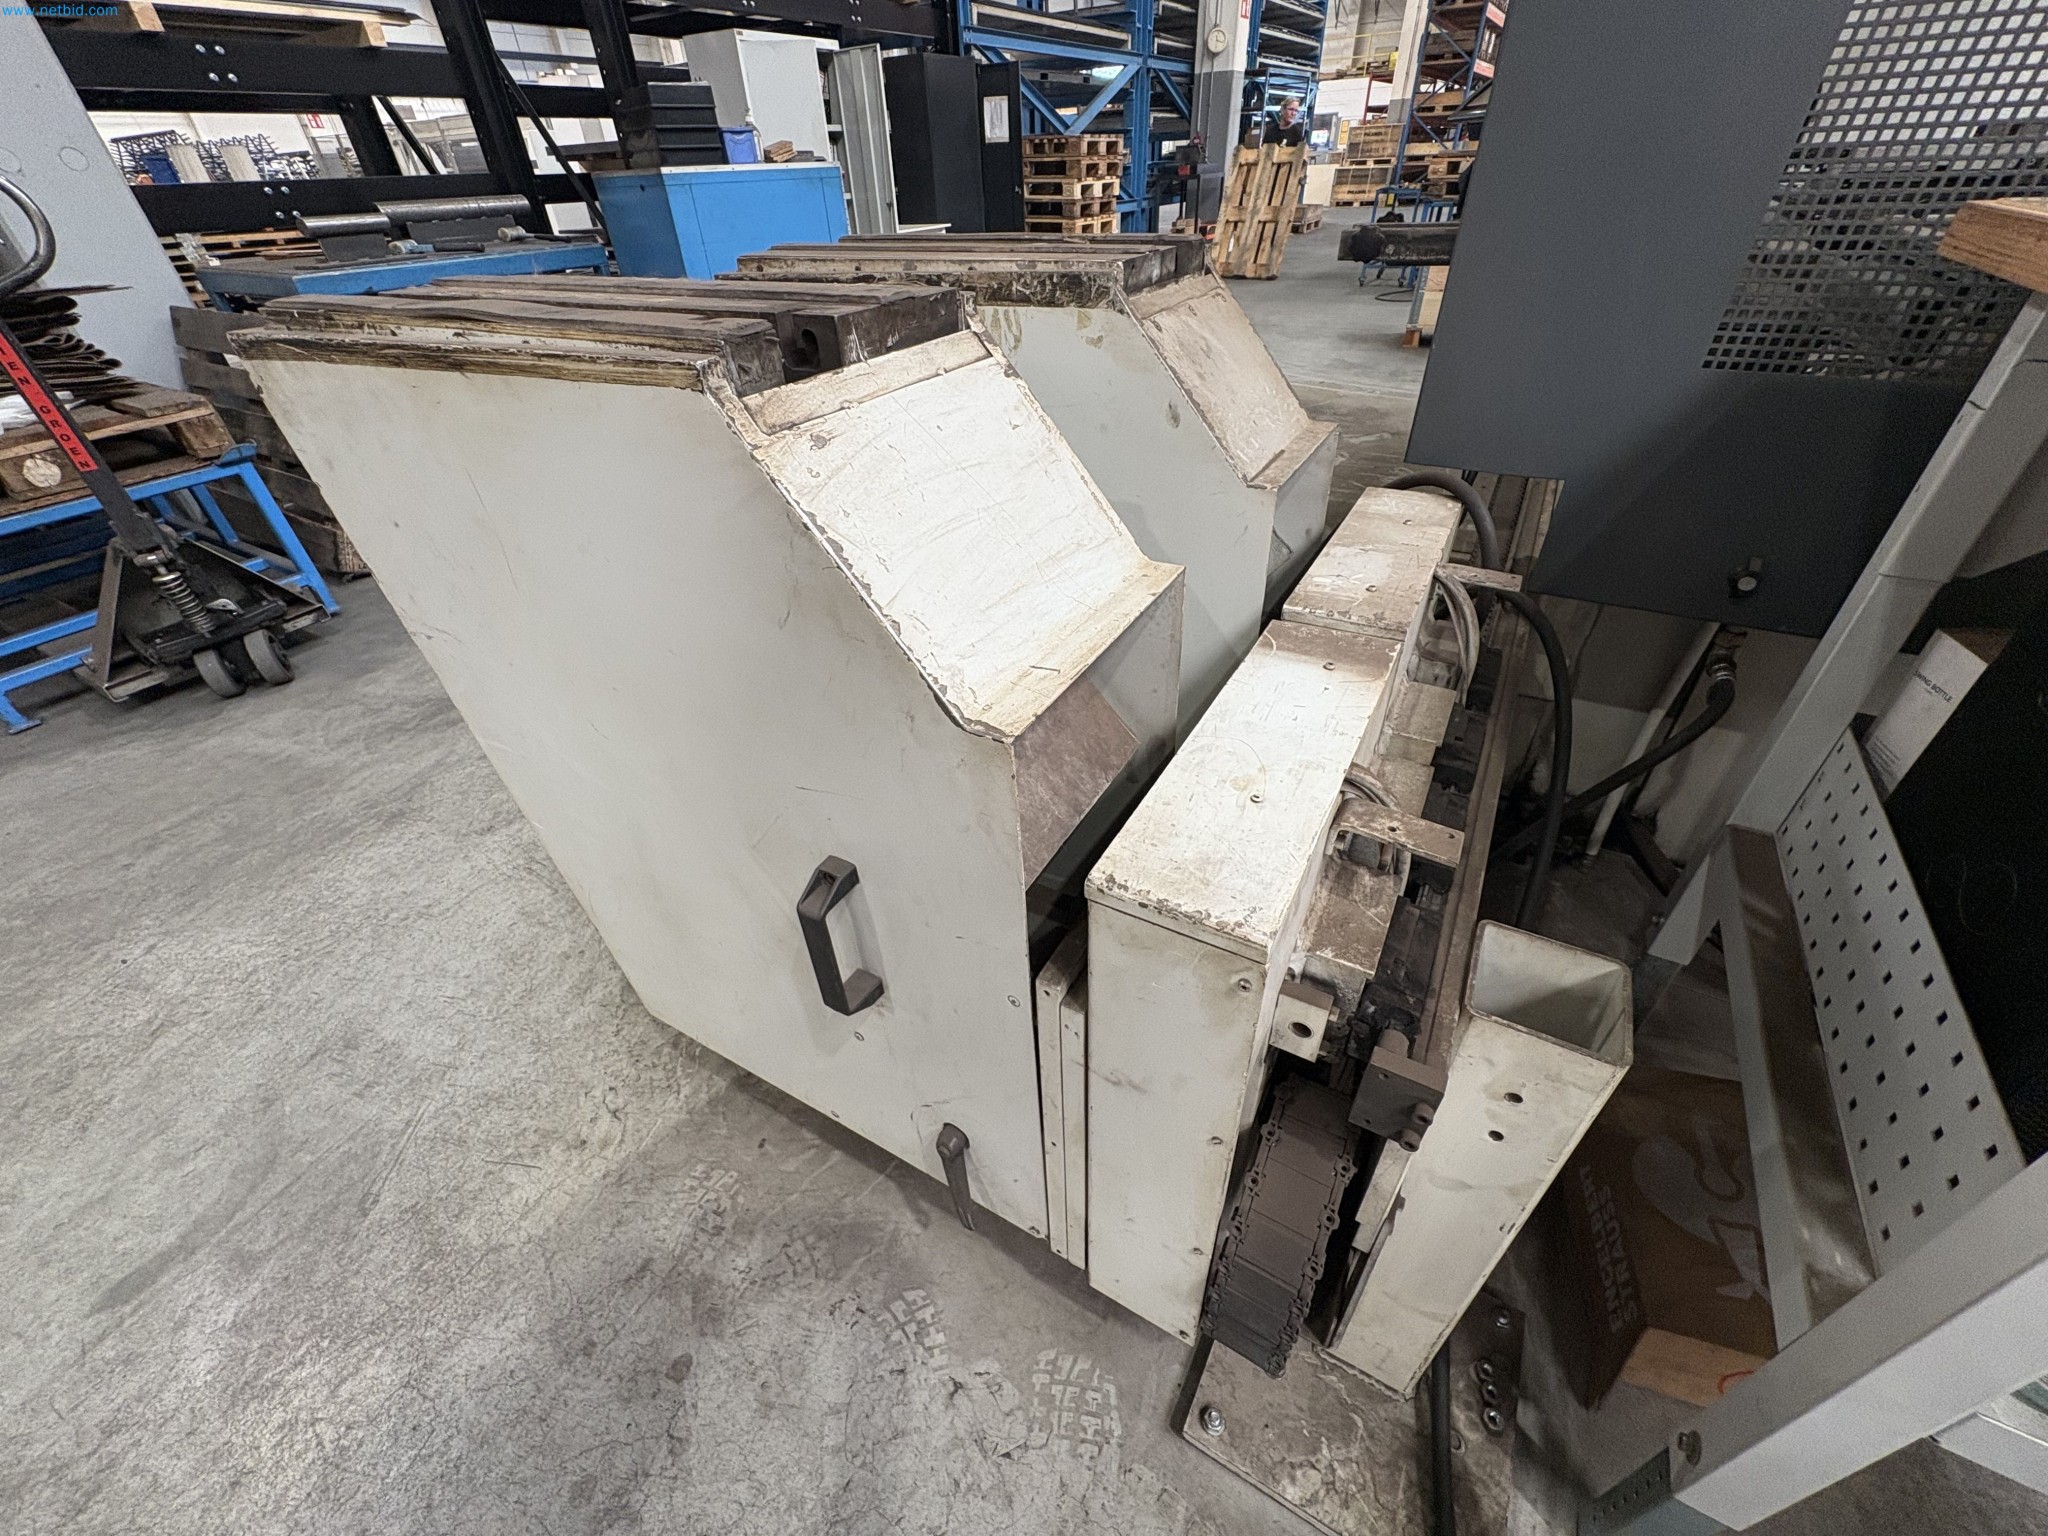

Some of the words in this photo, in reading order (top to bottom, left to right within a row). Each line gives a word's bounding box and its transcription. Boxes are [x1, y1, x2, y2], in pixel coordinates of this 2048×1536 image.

[40, 405, 91, 469] GROEN
[1912, 670, 1932, 687] SWING
[1930, 683, 1953, 703] BOTTLE
[1600, 1184, 1638, 1325] STRAUSS
